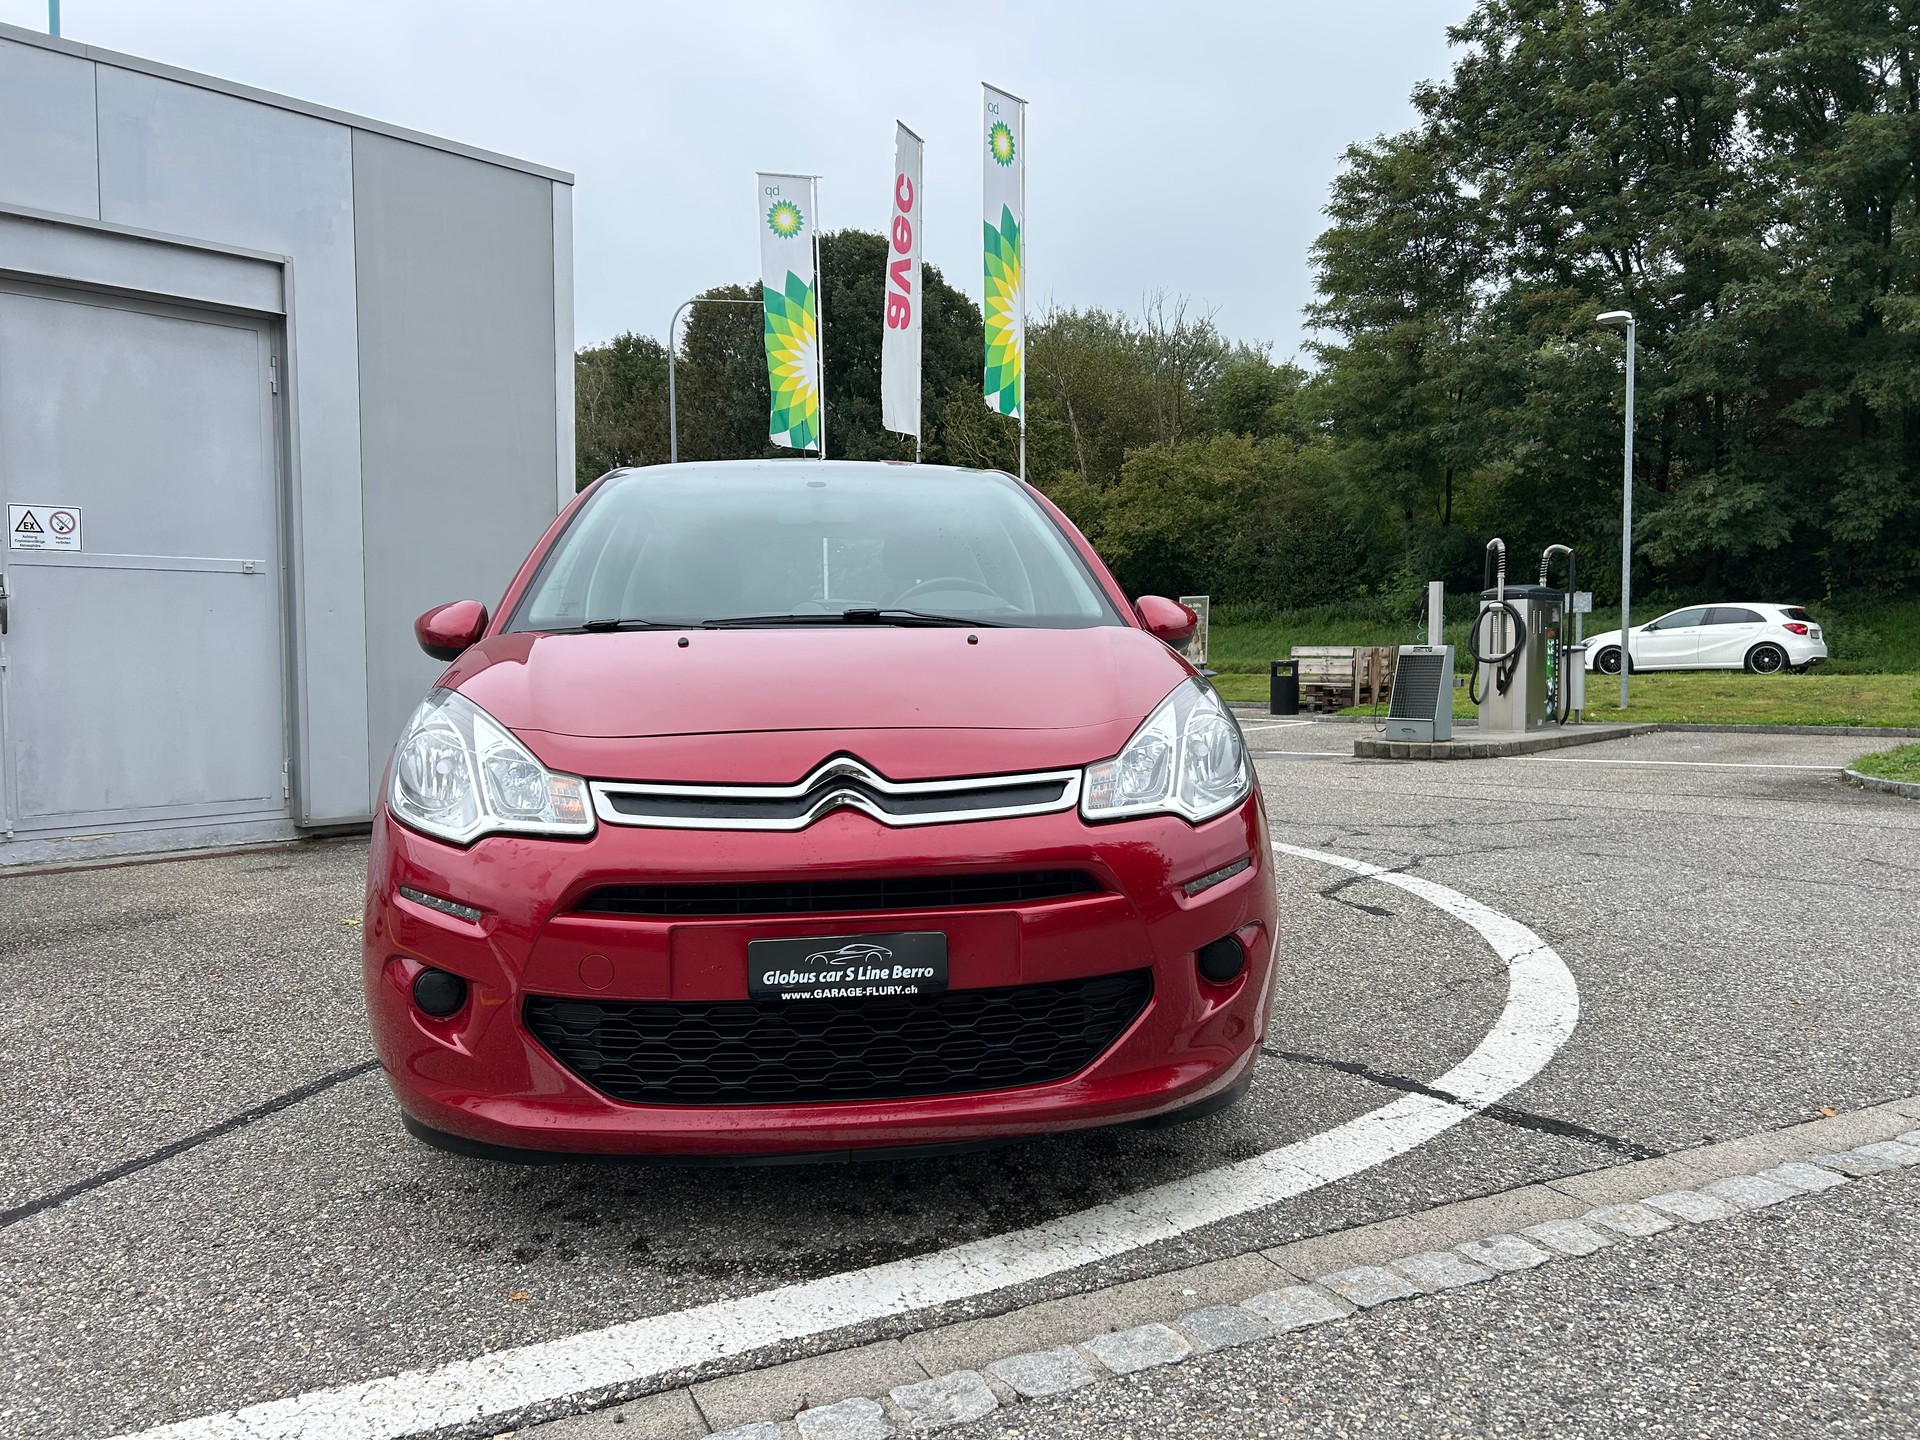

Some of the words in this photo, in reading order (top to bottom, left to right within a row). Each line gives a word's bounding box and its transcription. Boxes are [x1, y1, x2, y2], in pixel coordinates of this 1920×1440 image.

[23, 522, 35, 530] EX
[762, 969, 816, 986] Globus
[818, 971, 844, 983] car
[845, 967, 855, 982] S
[857, 965, 890, 981] Line
[892, 964, 934, 980] Berro
[781, 985, 918, 1000] www.GARAGE-FLURY.ch
